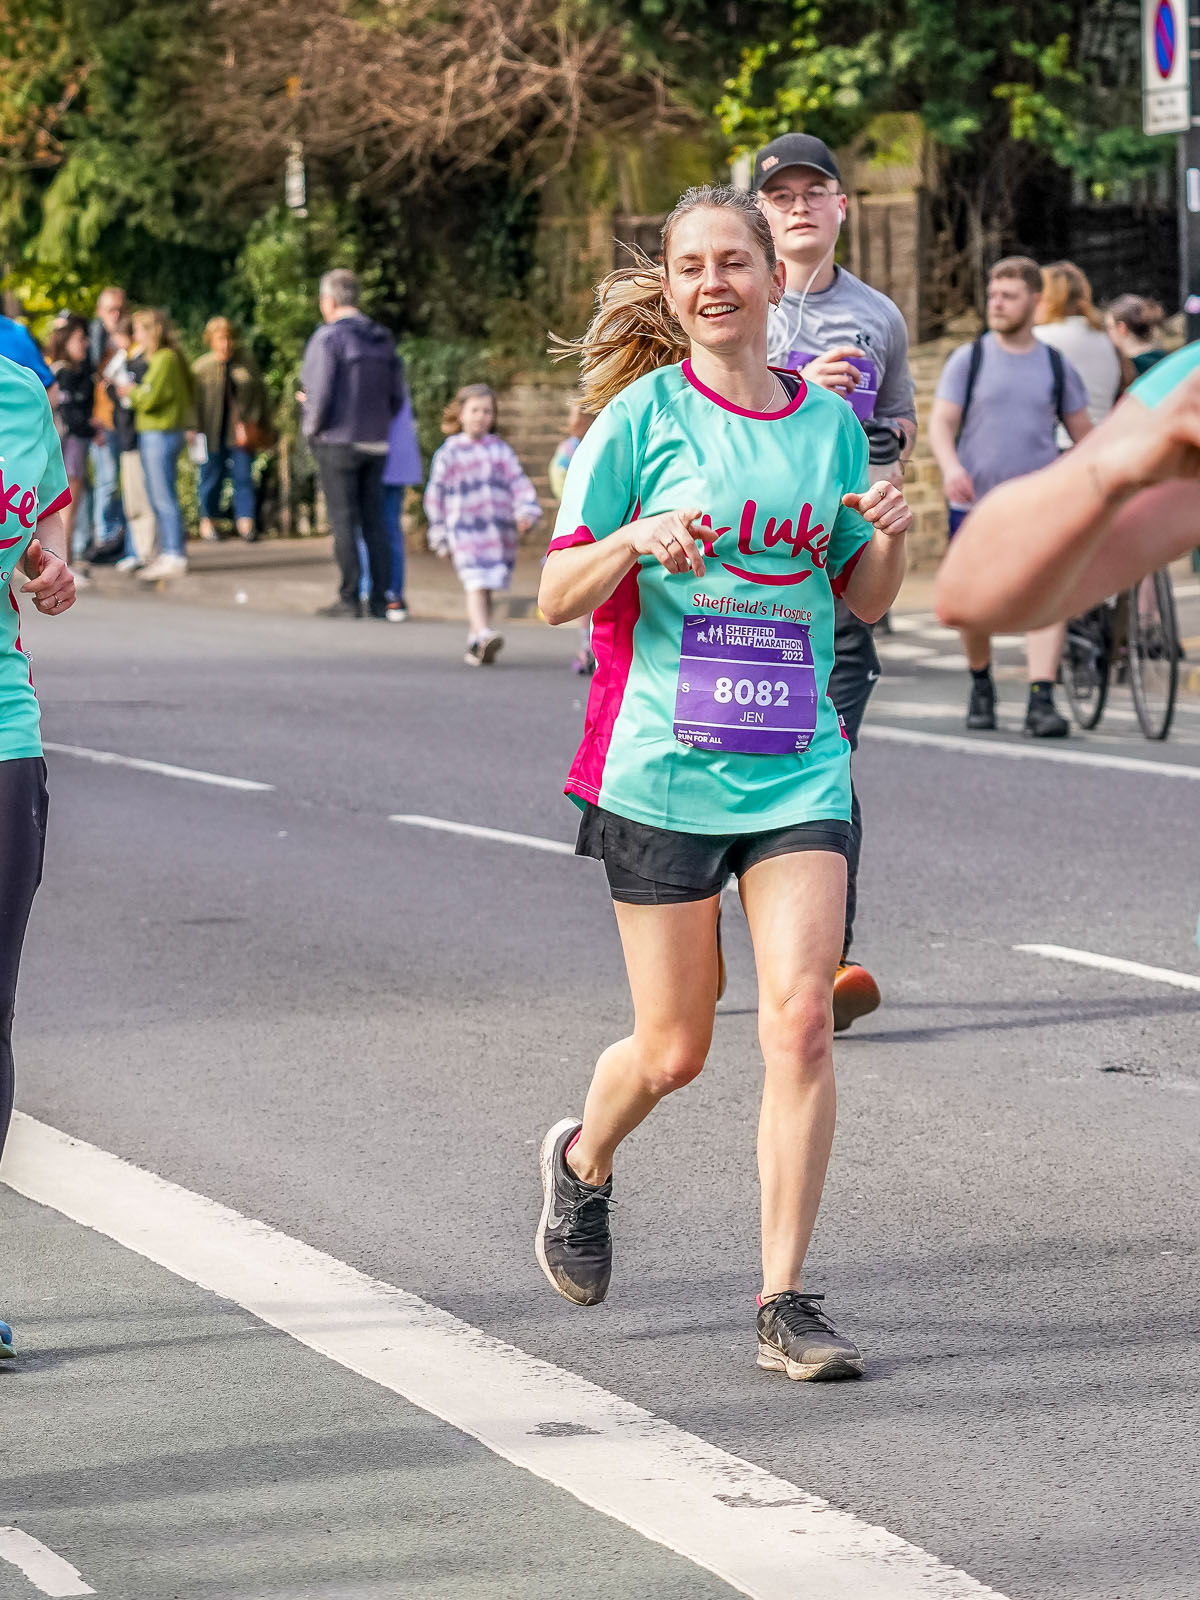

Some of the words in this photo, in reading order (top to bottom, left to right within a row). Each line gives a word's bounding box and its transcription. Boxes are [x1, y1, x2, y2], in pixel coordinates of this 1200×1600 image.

[692, 593, 767, 615] Sheffield's
[772, 604, 812, 623] Hospice
[727, 625, 774, 637] SHEFFIELD
[726, 636, 754, 647] HALF
[754, 638, 802, 650] MARATHON
[782, 650, 804, 661] 2022
[681, 682, 690, 693] S
[713, 677, 789, 706] 8082
[739, 711, 764, 723] JEN
[677, 734, 693, 742] RUN
[694, 735, 708, 743] FOR
[709, 736, 722, 744] ALL
